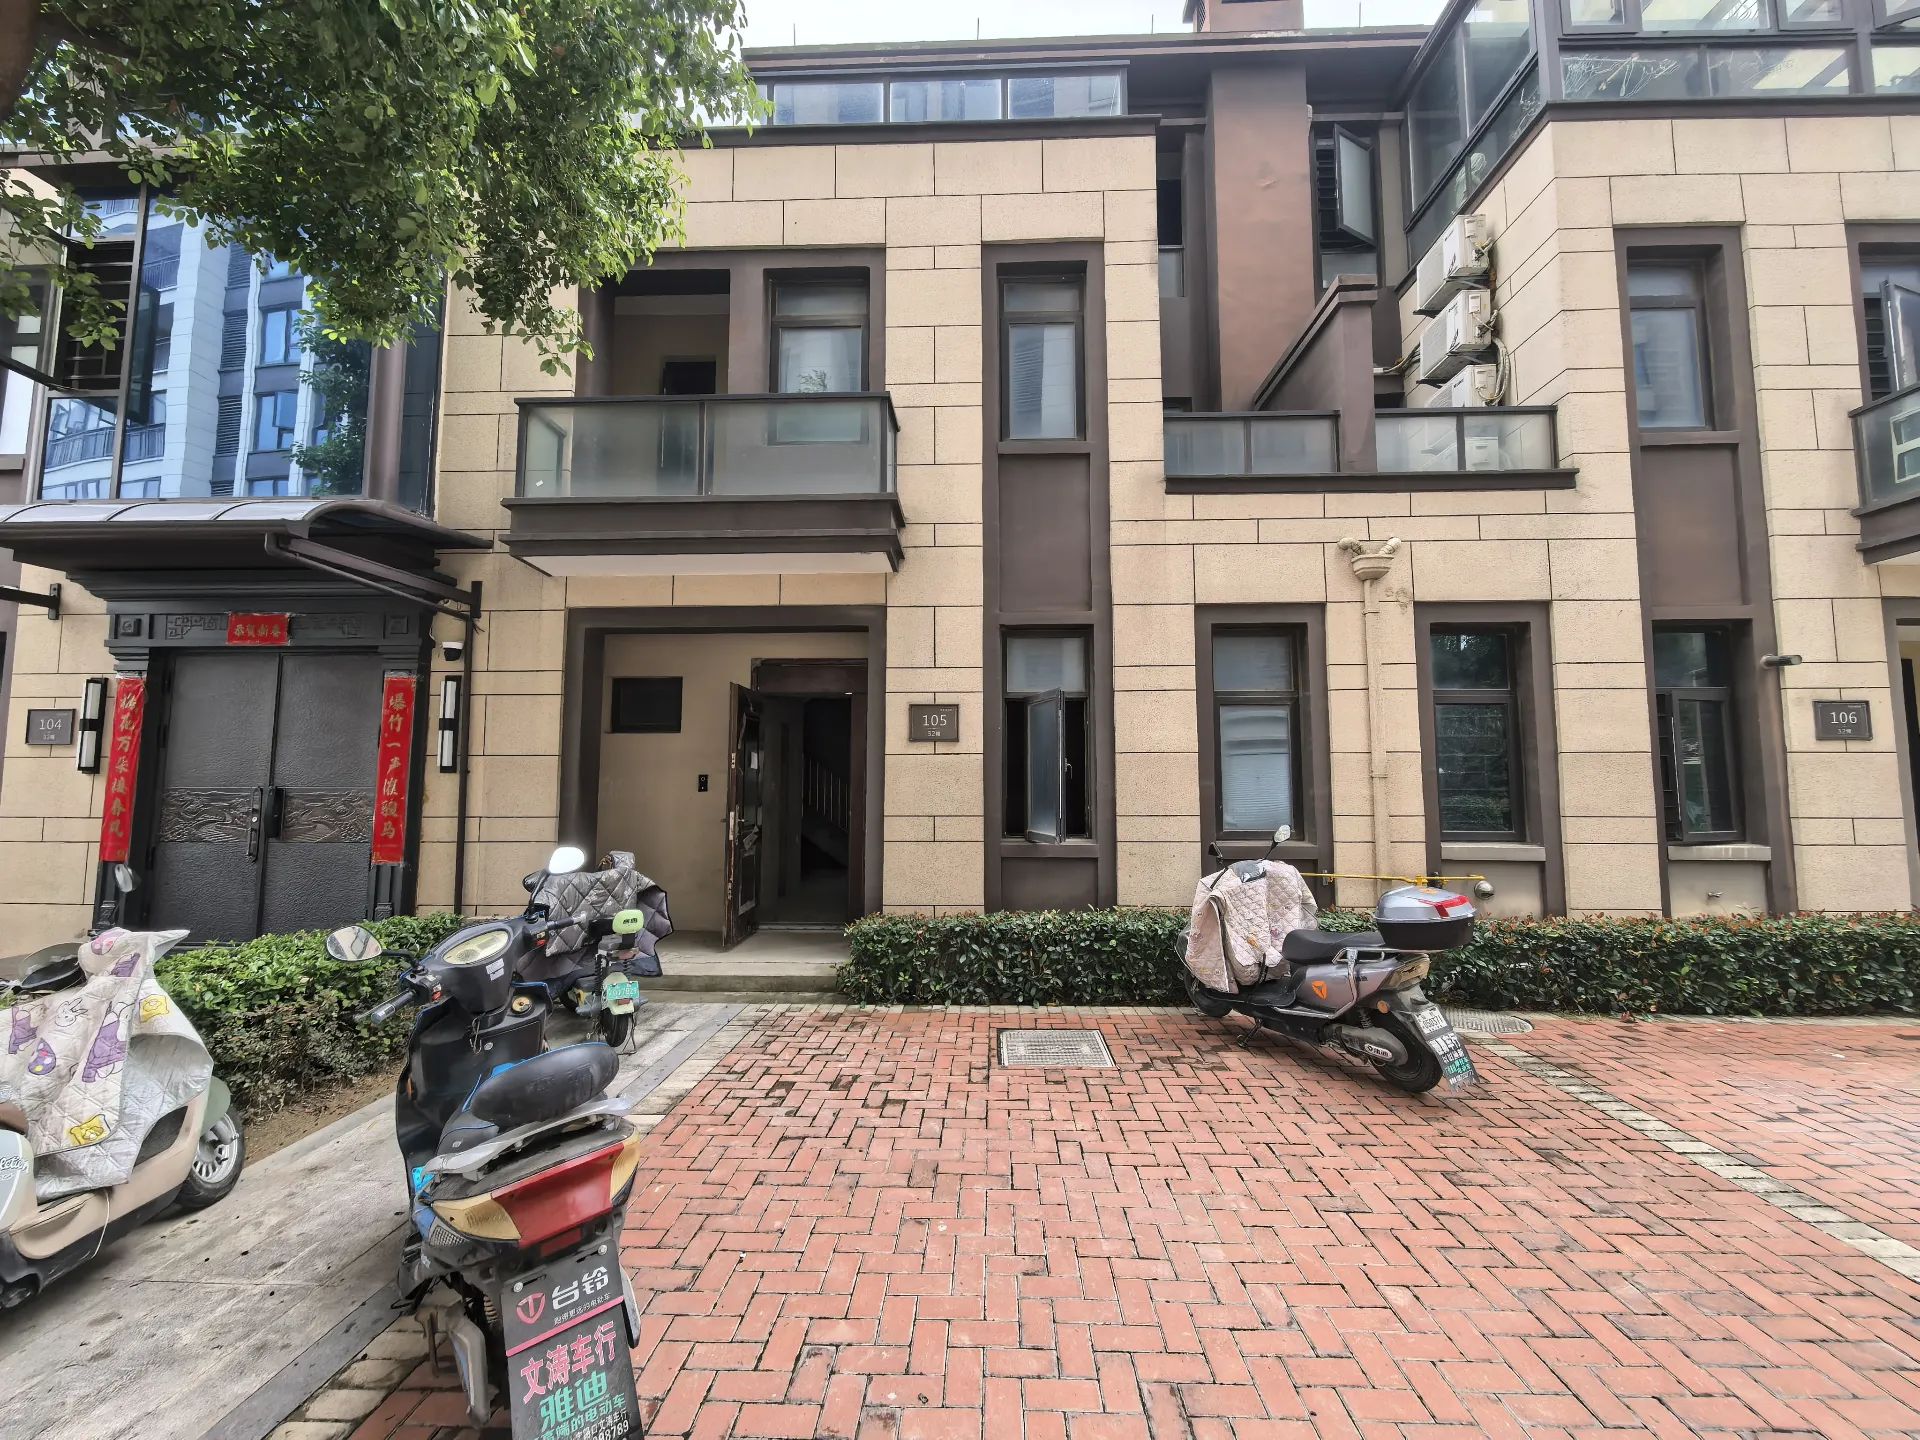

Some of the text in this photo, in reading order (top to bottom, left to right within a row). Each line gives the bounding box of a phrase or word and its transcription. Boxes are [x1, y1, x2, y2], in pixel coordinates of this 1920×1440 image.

[39, 718, 63, 730] 104
[922, 714, 947, 726] 105
[1830, 711, 1857, 724] 106
[551, 1266, 609, 1310] 台铃
[520, 1320, 617, 1404] 文涛车行
[534, 1393, 626, 1440] 高端的电动车
[540, 1370, 611, 1433] 雅迪
